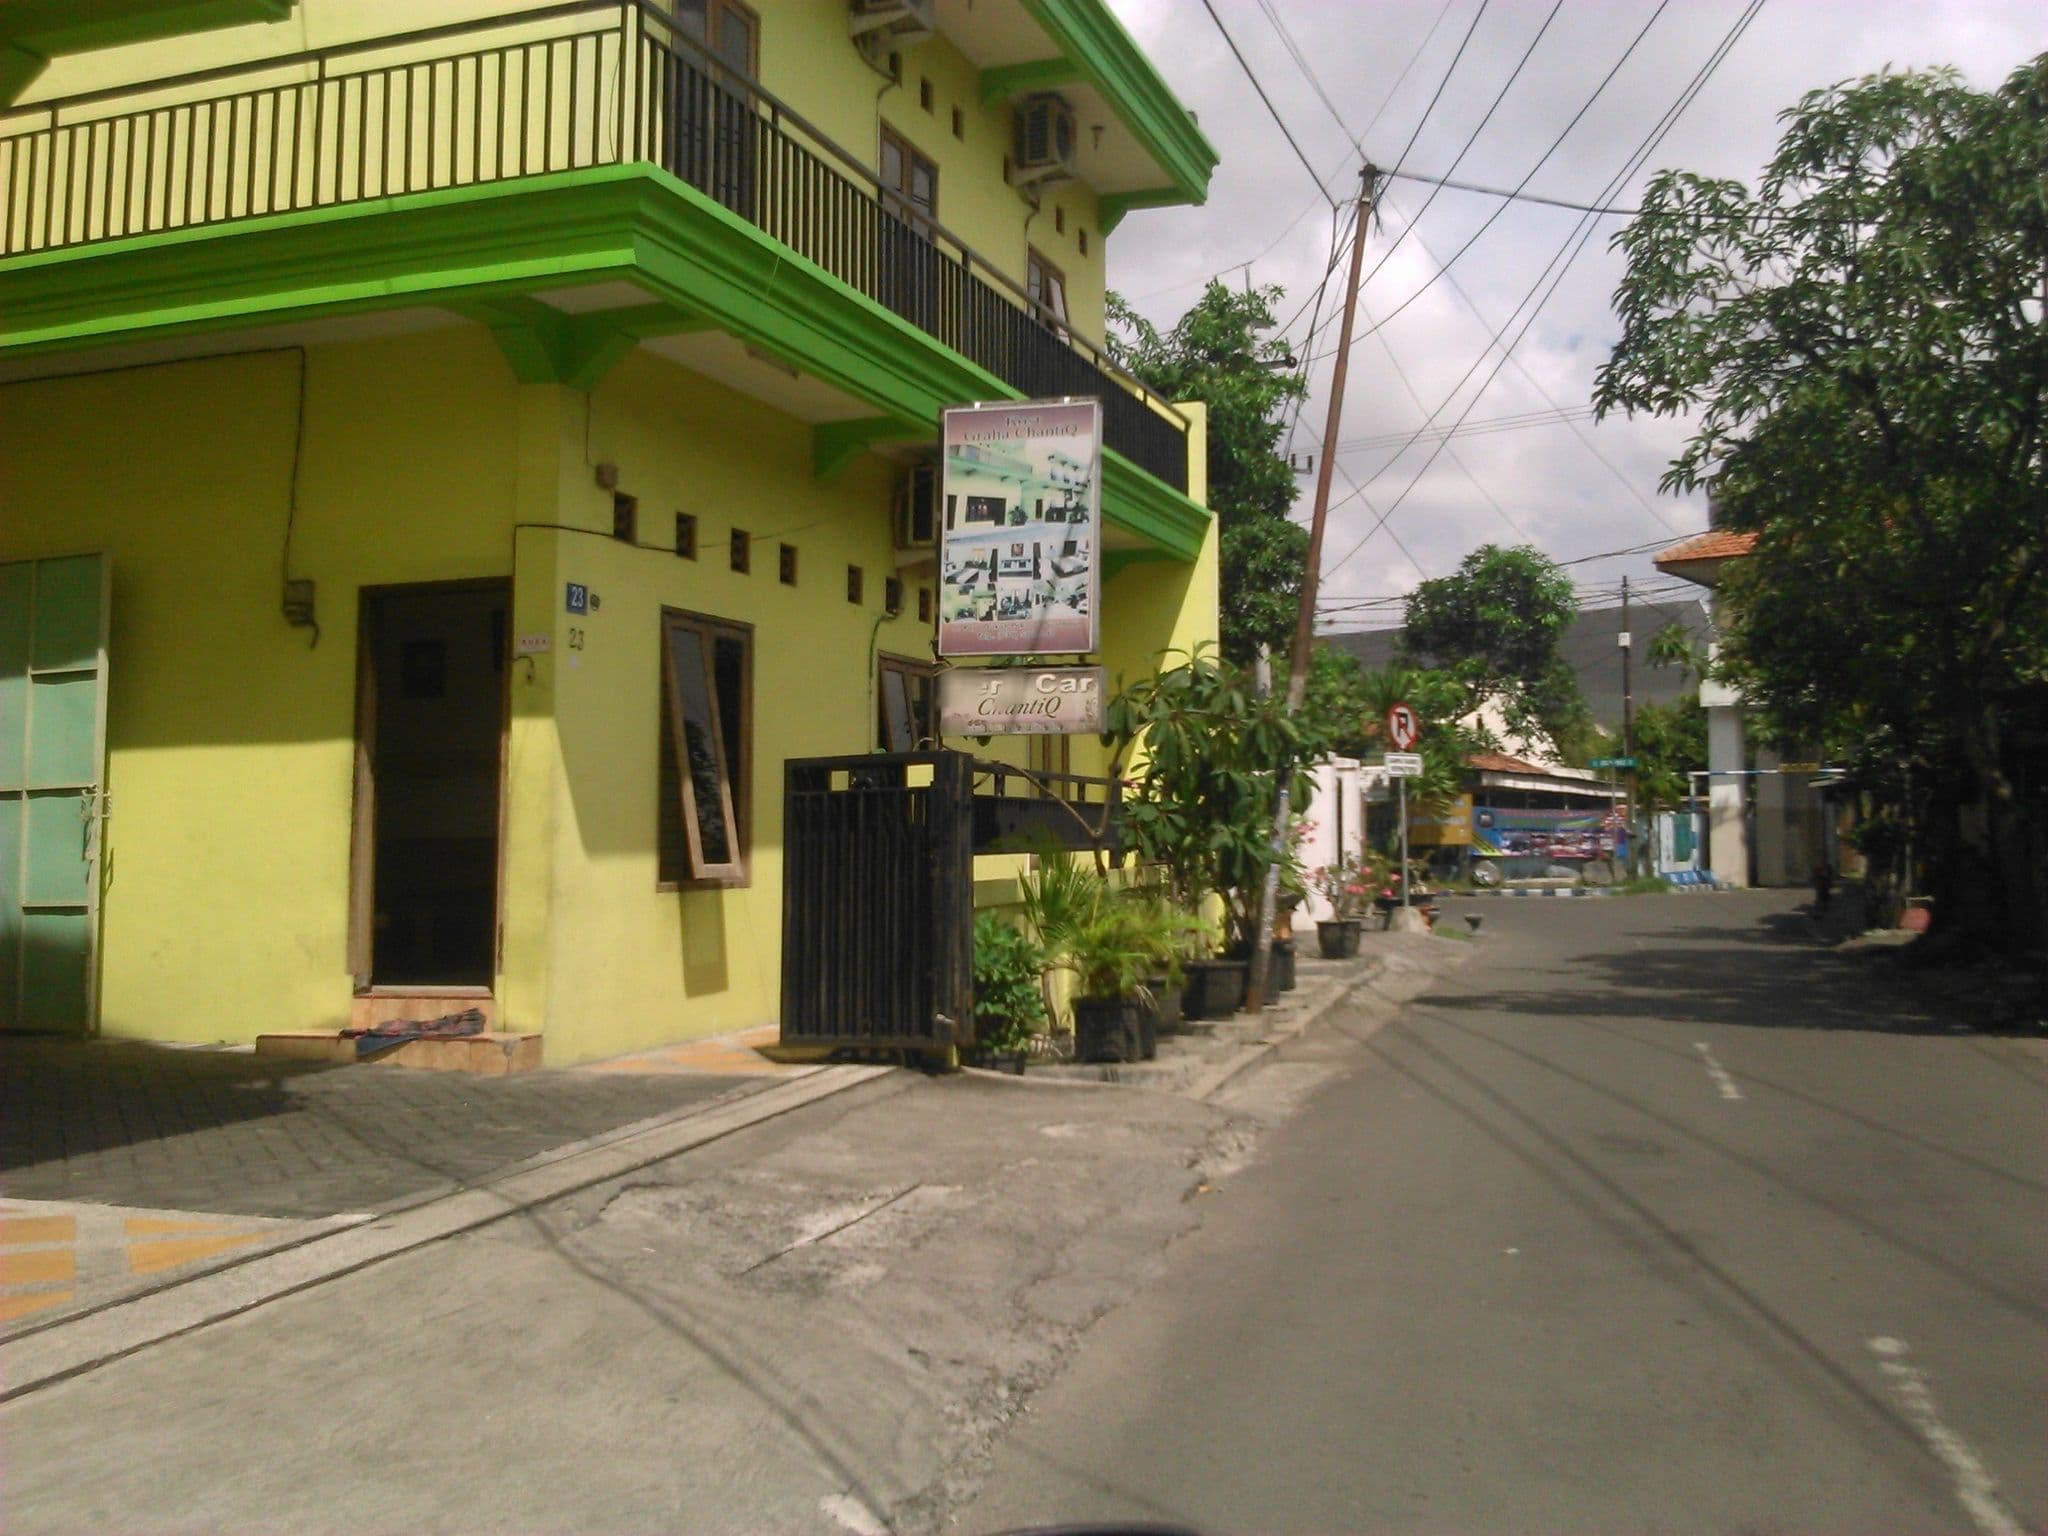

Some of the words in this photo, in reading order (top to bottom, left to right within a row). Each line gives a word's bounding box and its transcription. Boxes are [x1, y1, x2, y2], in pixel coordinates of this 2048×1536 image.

[571, 586, 584, 607] 23
[569, 628, 585, 651] 23
[977, 696, 1062, 718] CantiQ
